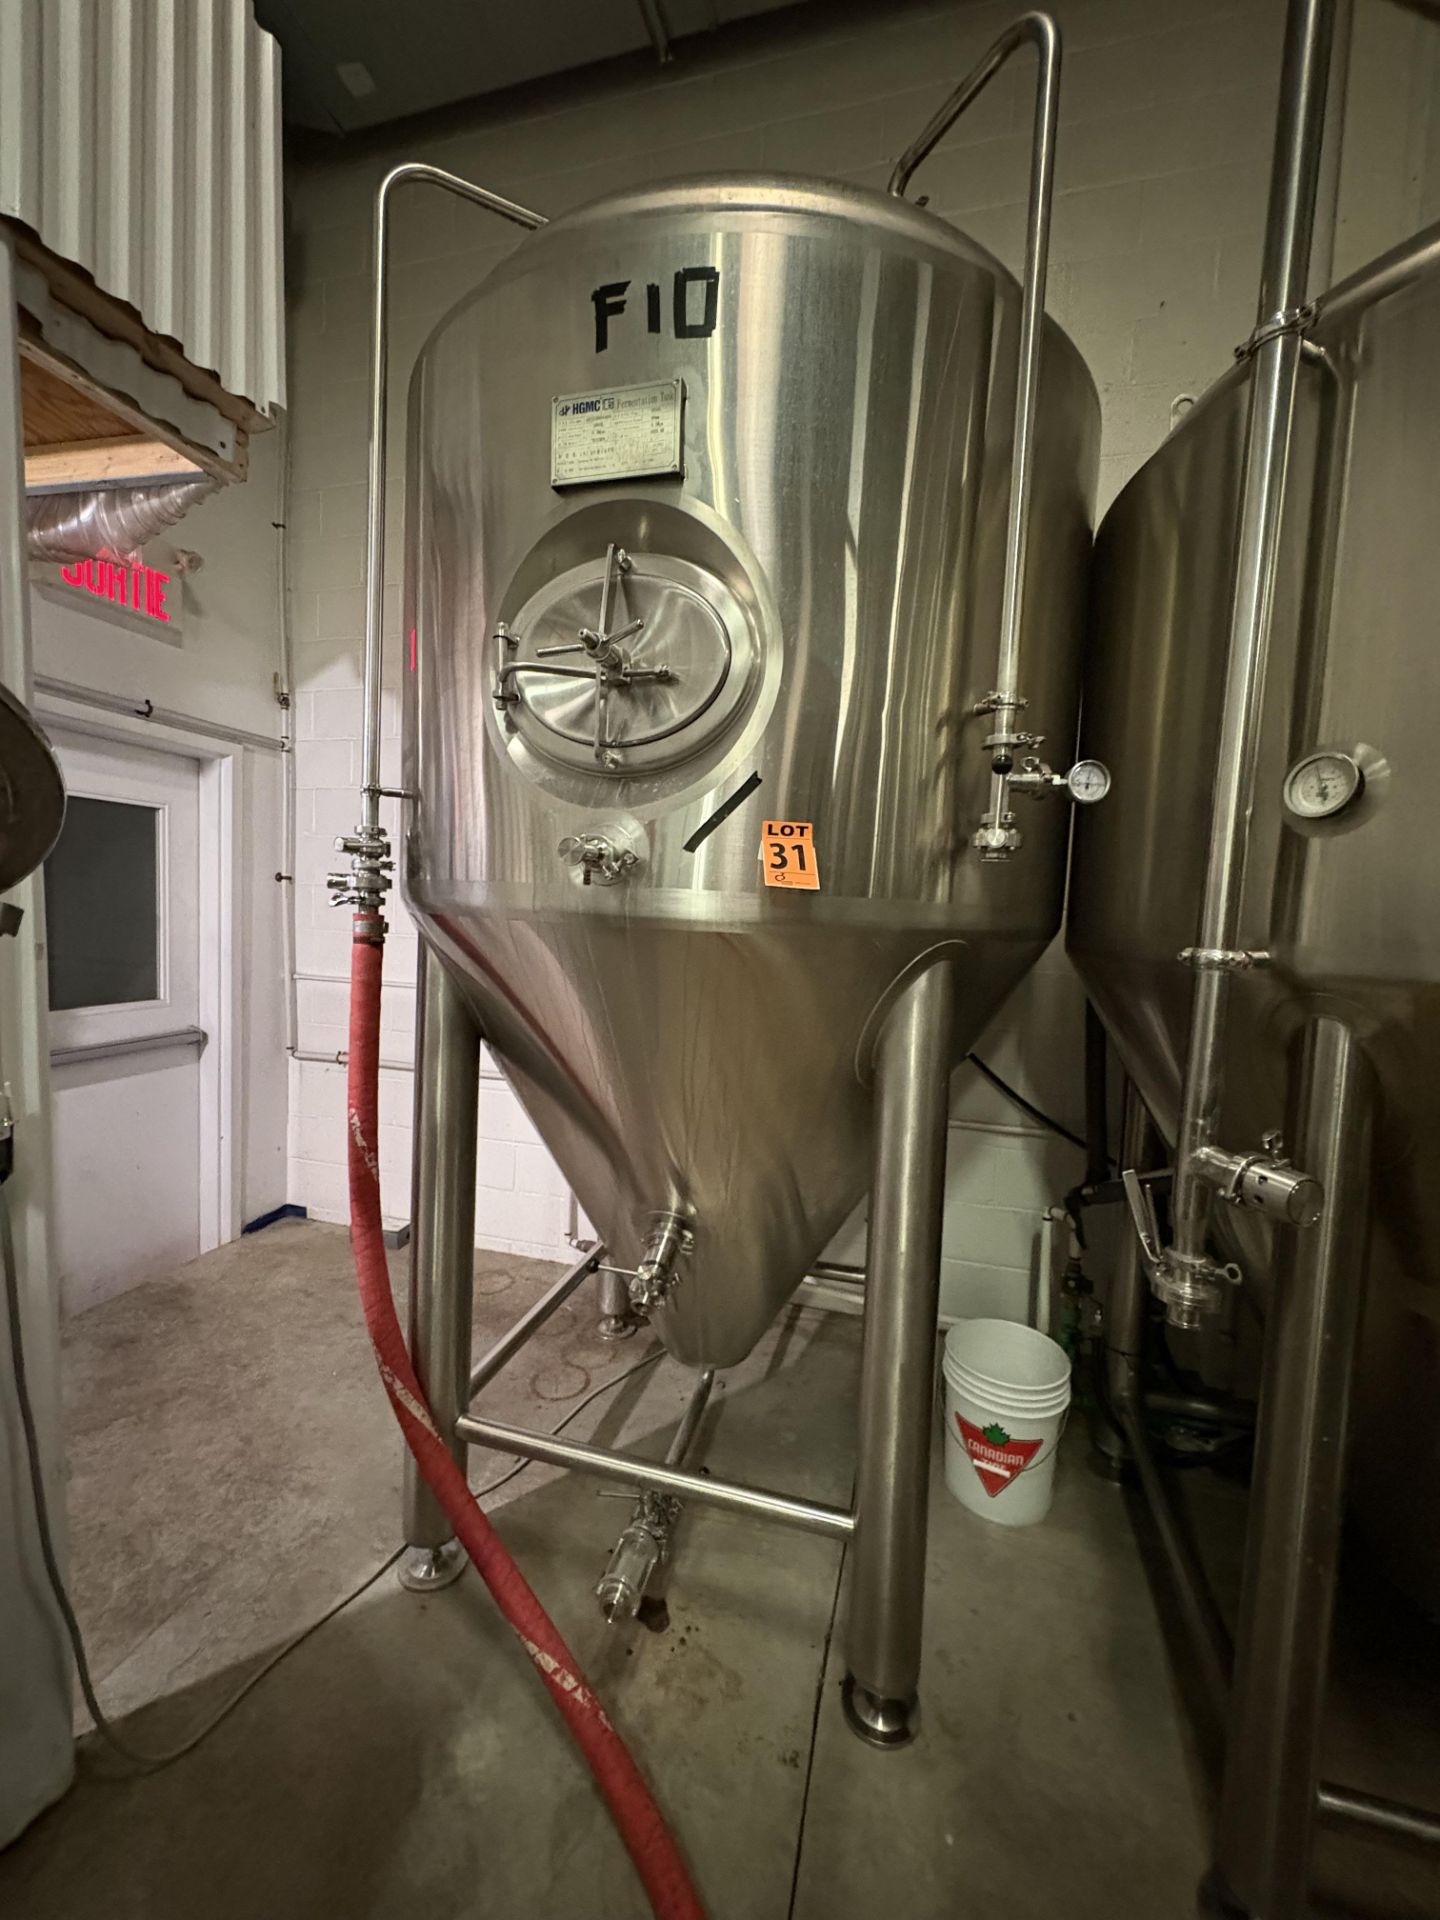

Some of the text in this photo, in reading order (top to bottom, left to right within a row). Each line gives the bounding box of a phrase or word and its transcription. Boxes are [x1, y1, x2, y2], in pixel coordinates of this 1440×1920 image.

[591, 266, 720, 354] F10
[572, 400, 601, 416] HGMC
[767, 824, 809, 838] LOT
[769, 843, 807, 872] 31
[967, 1438, 1025, 1467] CANADIAN
